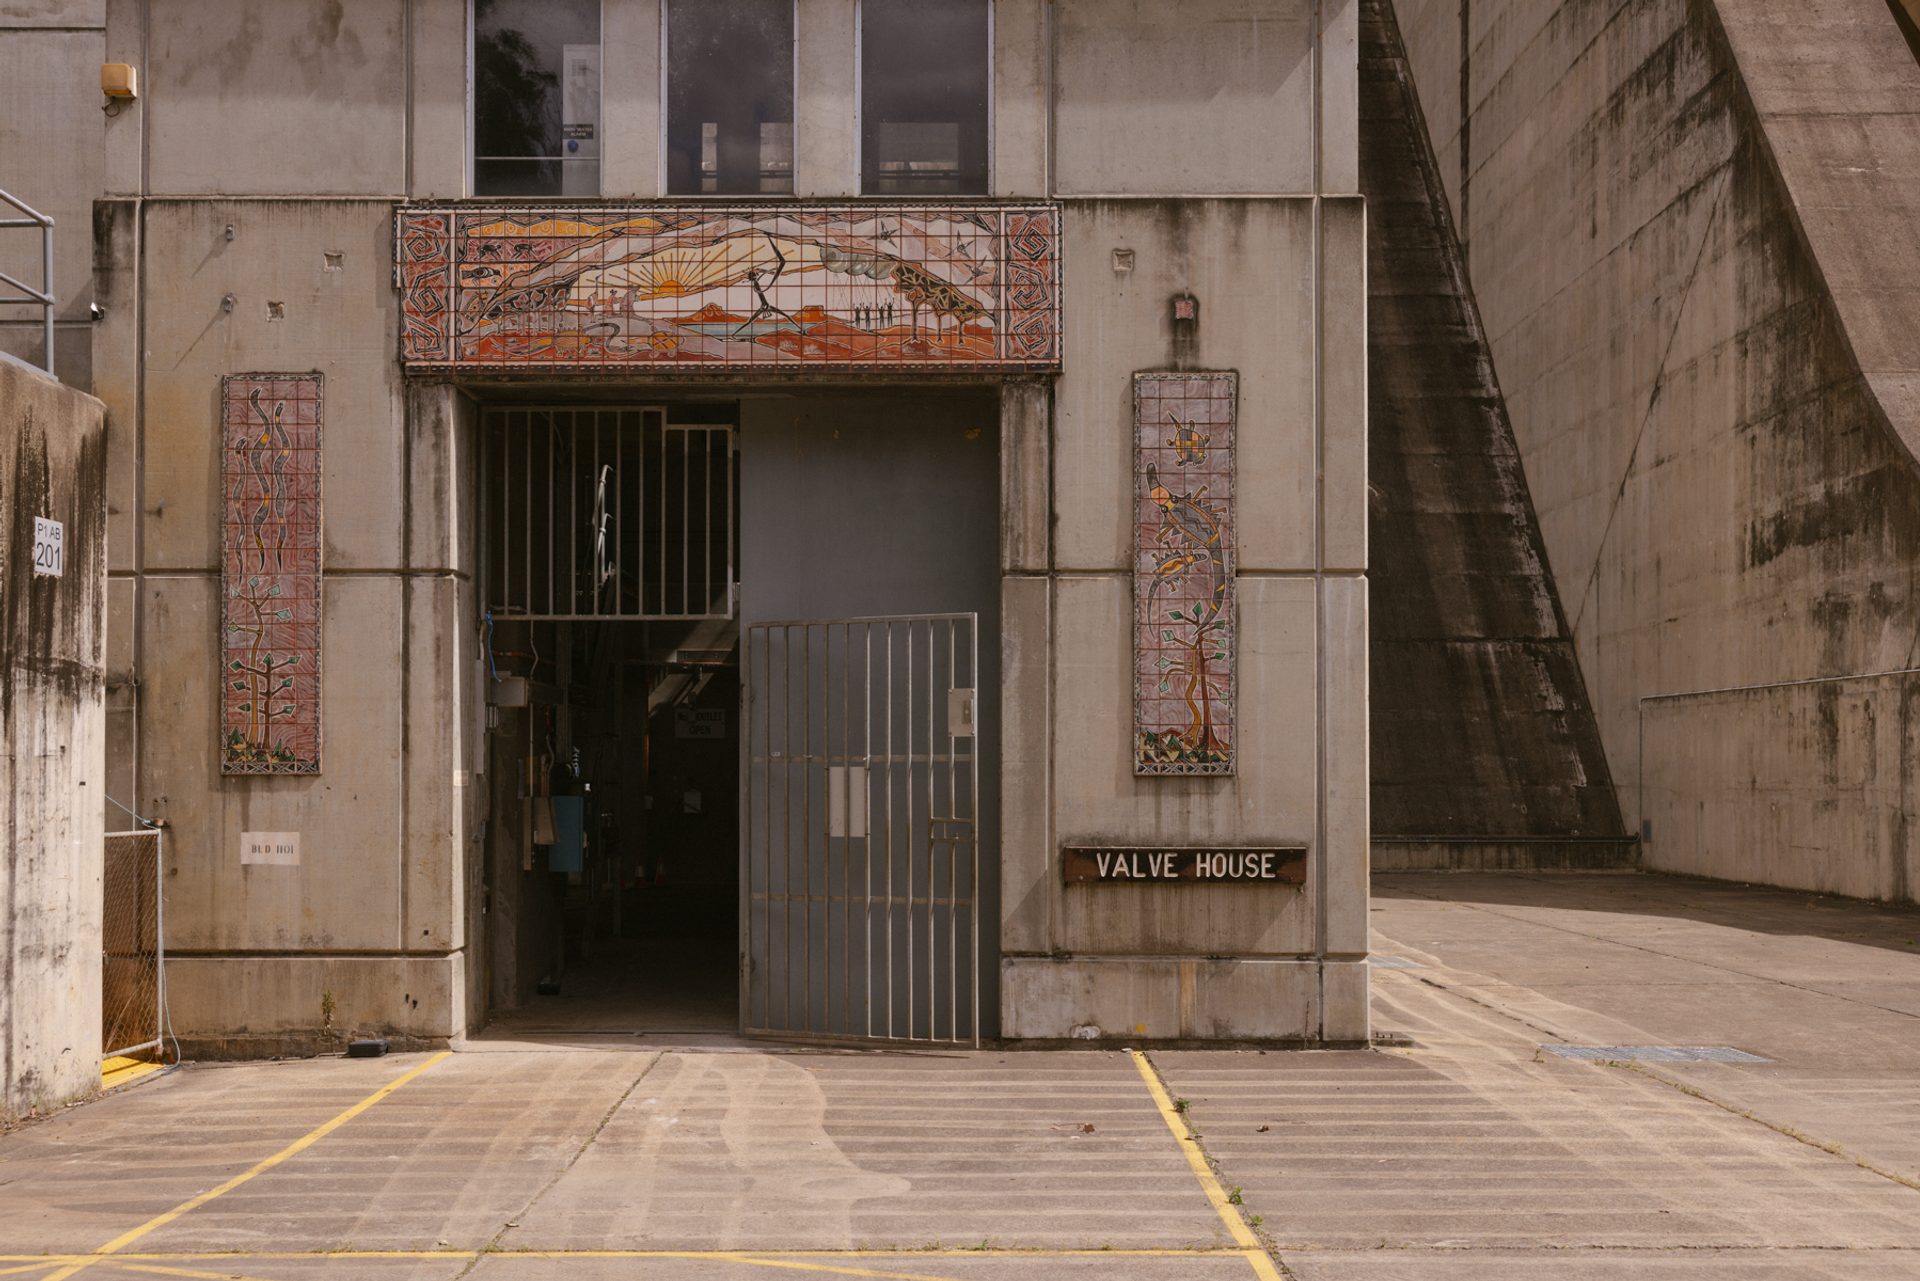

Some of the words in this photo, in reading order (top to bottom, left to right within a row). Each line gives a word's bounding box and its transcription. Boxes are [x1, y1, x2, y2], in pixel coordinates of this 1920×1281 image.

[37, 522, 48, 537] P1
[50, 526, 60, 540] AB
[36, 542, 60, 570] 201
[1096, 852, 1179, 878] VALVE
[1196, 852, 1276, 878] HOUSE
